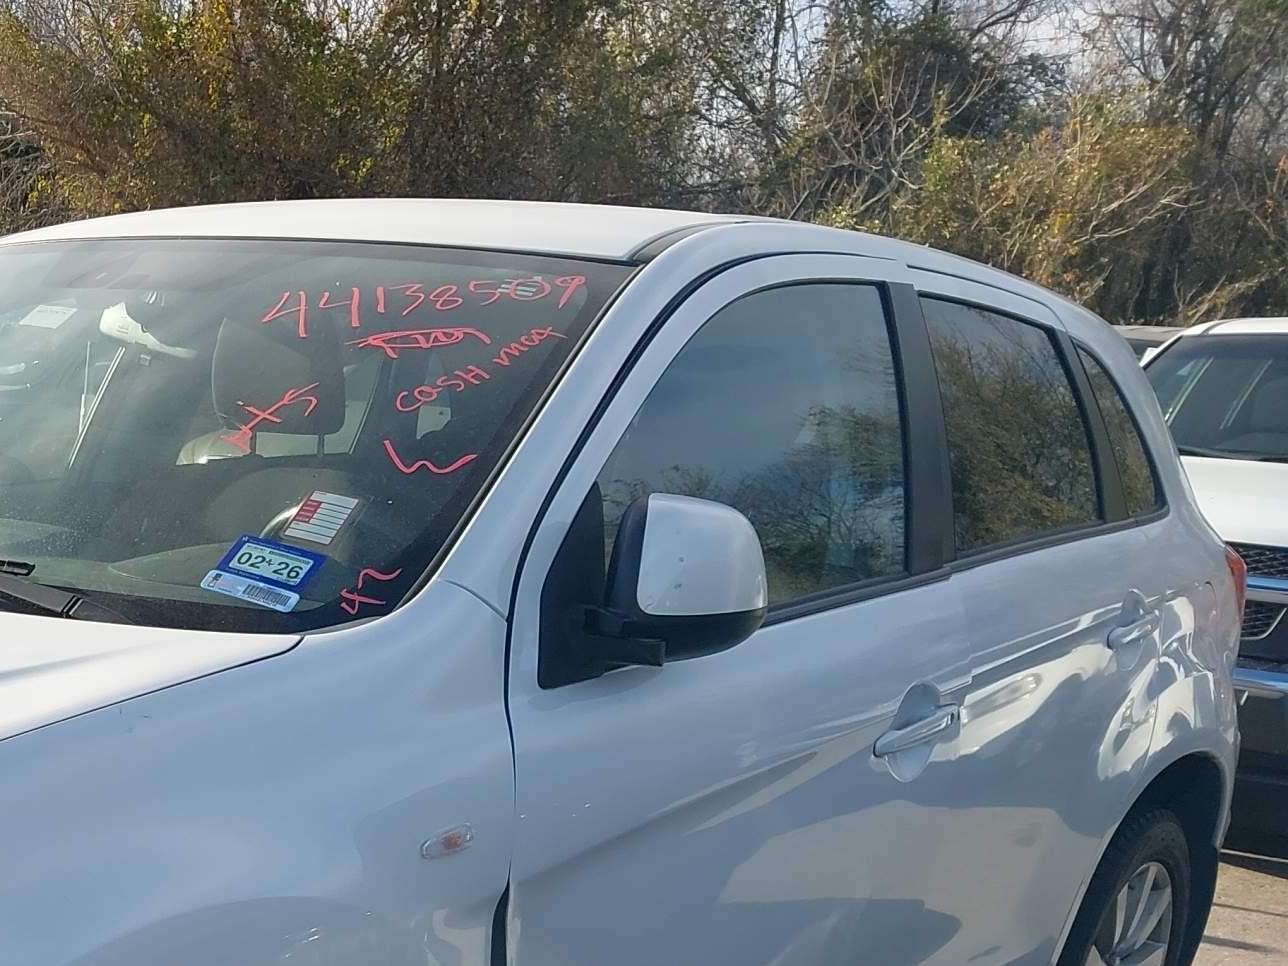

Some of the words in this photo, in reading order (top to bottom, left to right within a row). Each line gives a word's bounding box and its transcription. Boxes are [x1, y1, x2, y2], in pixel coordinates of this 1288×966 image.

[263, 275, 585, 338] 44138509
[237, 551, 266, 569] 02
[272, 561, 303, 579] 26
